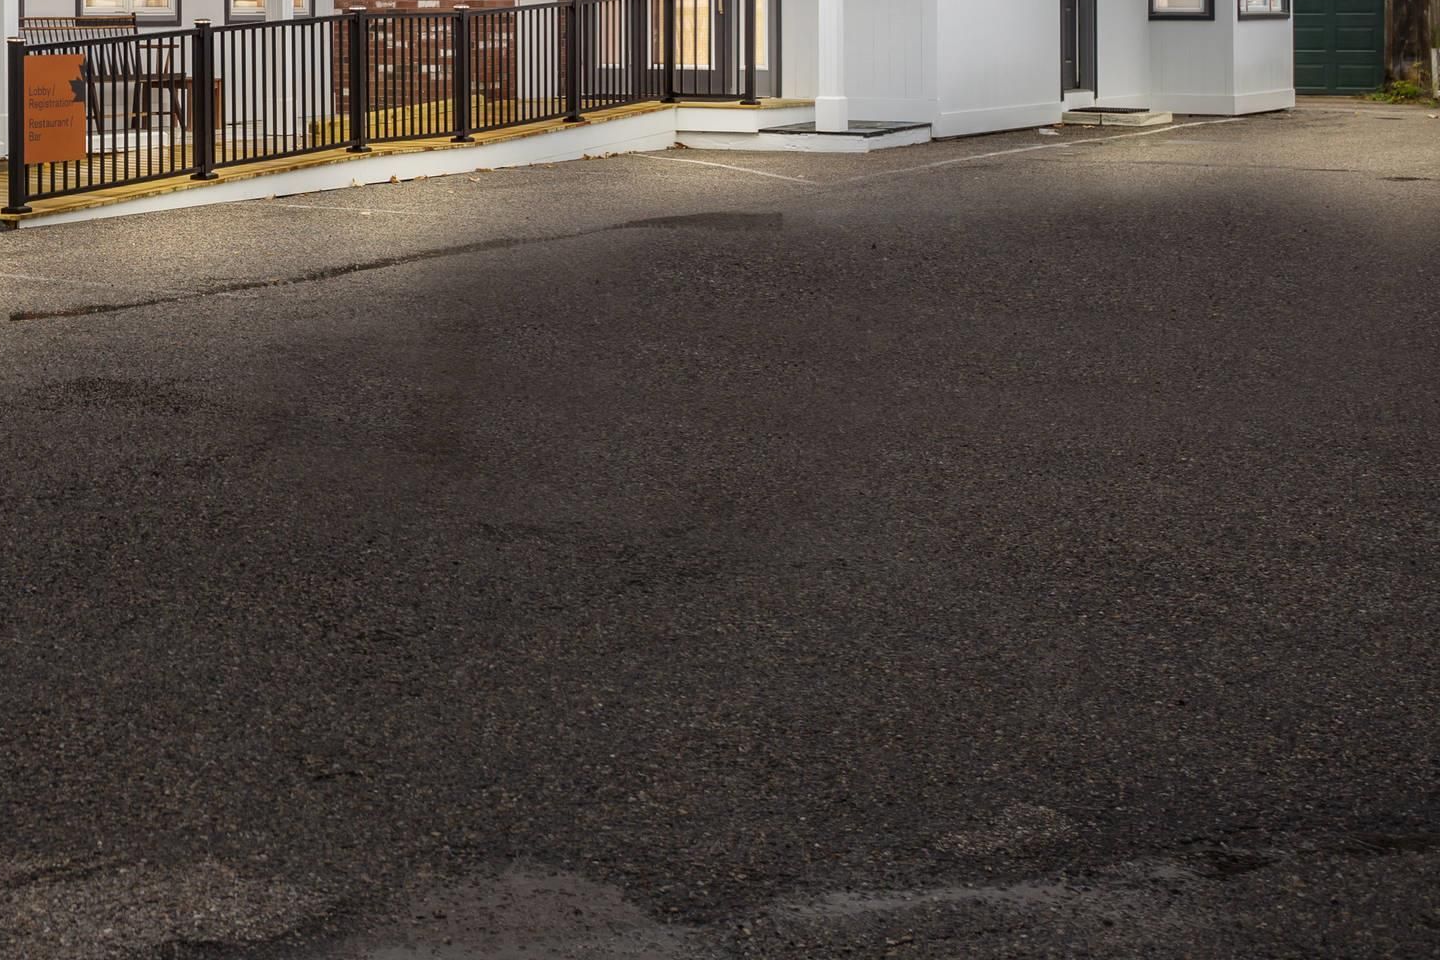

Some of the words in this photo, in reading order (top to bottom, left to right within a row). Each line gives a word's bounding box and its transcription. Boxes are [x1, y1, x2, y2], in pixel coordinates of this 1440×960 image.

[28, 86, 51, 98] Lobby
[28, 98, 73, 111] Registration
[28, 117, 69, 129] Restaurant
[28, 131, 41, 142] Bar
